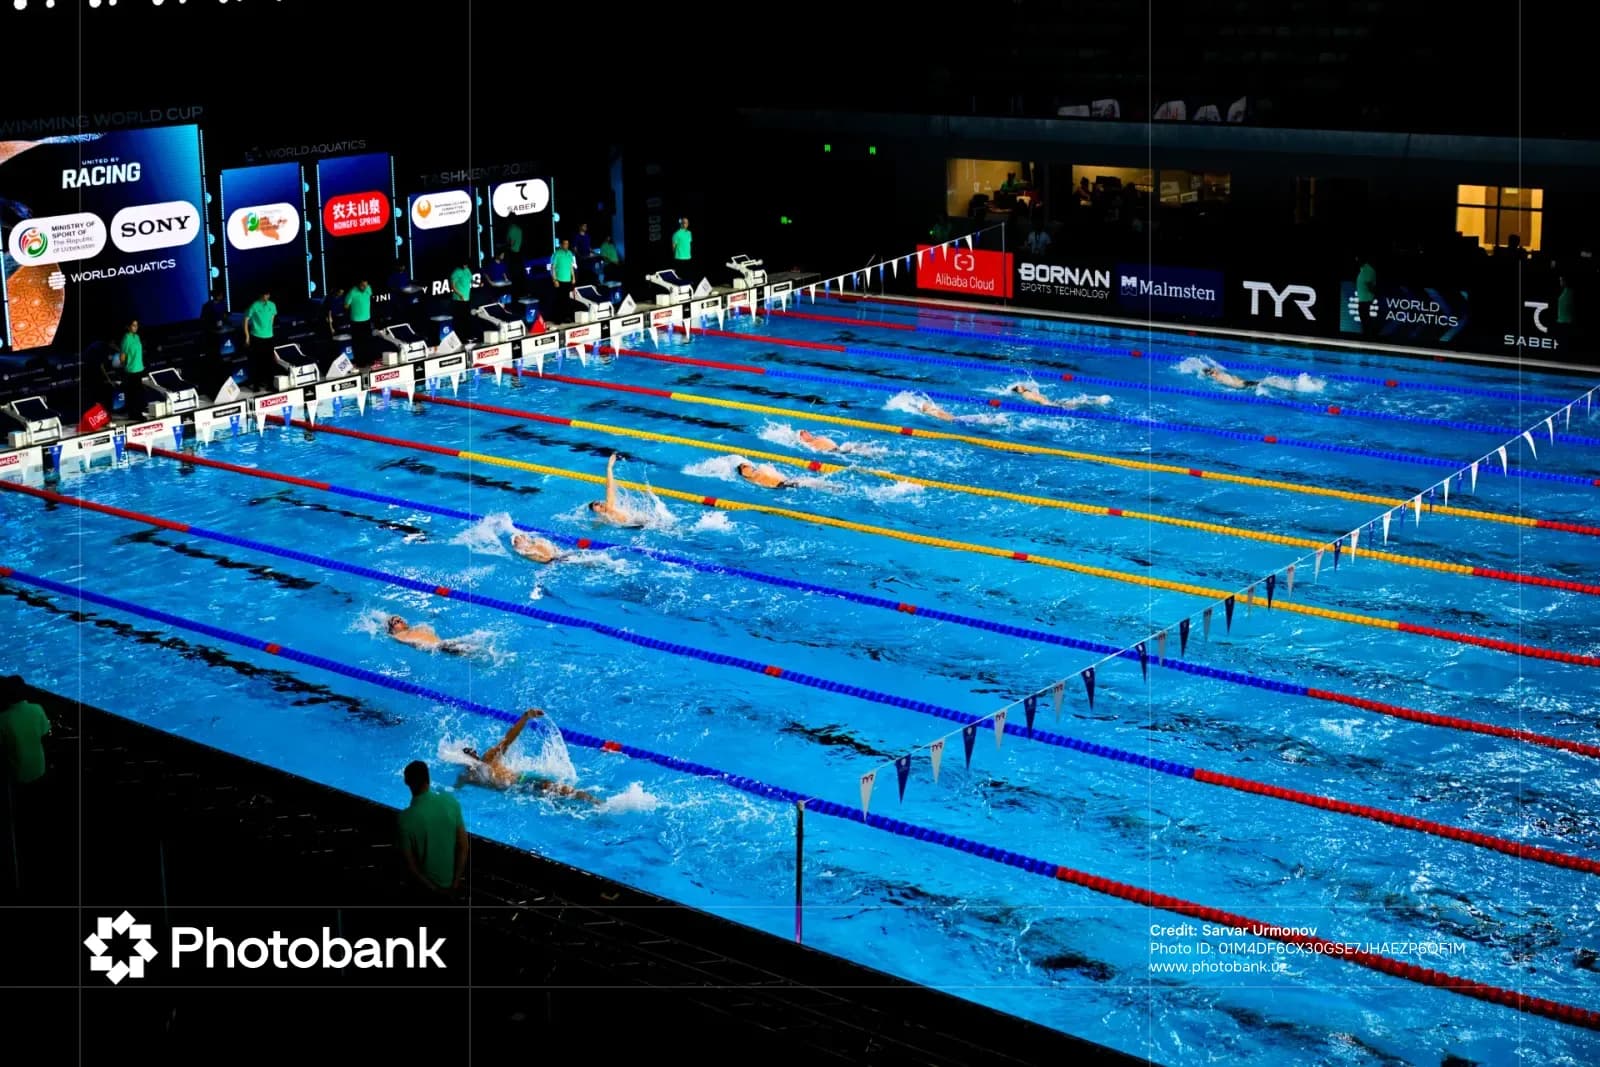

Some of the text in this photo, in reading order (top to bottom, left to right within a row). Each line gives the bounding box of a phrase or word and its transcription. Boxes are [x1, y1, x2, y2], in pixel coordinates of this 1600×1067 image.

[93, 109, 162, 126] WORLD
[166, 105, 204, 120] CUP
[265, 139, 367, 160] WORLD AQUATICS
[82, 158, 109, 166] UNITED
[62, 162, 141, 189] RACING
[333, 197, 380, 221] 农夫山泉
[51, 222, 85, 231] MINISTRY
[121, 215, 191, 238] SONY
[360, 216, 380, 227] SPRING
[52, 230, 76, 239] SPORT
[70, 258, 177, 283] WORLD AQUATICS
[1017, 263, 1110, 290] BORNAN
[935, 272, 995, 291] Alibaba Cloud
[1021, 282, 1110, 300] SPORTS TECHNOLOGY
[1140, 280, 1216, 301] Malmsten
[1242, 280, 1317, 320] TYR
[1386, 297, 1440, 313] WORLD
[1385, 310, 1460, 327] AQUATICS
